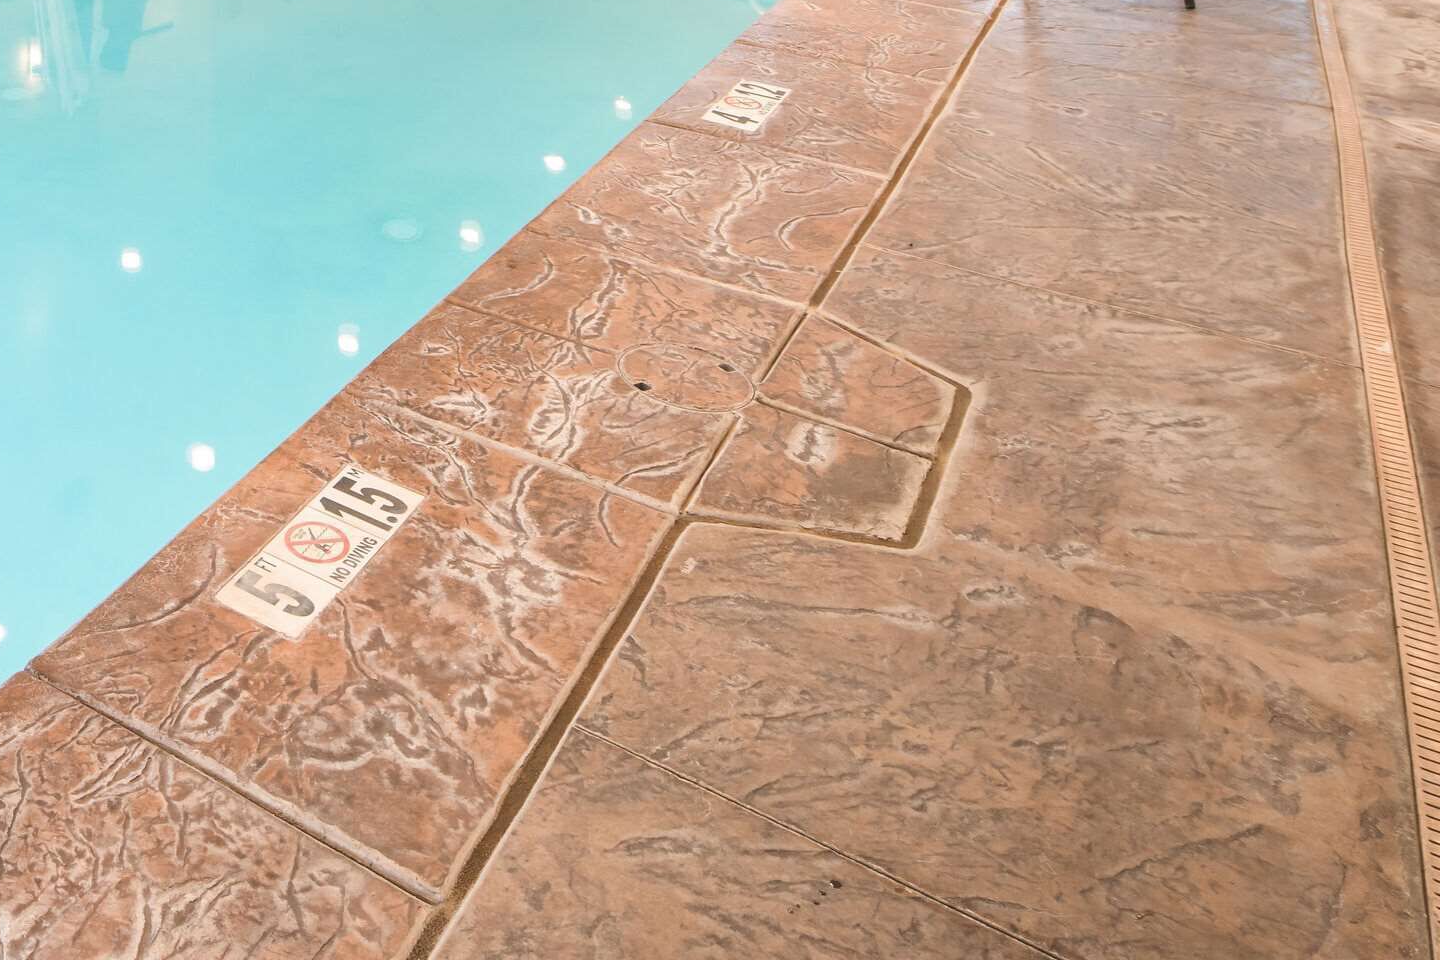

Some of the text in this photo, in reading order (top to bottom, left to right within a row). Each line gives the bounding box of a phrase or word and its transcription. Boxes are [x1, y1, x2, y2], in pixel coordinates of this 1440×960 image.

[234, 468, 408, 617] 5 FT 1.5 M
[330, 536, 378, 582] NO DIVING
